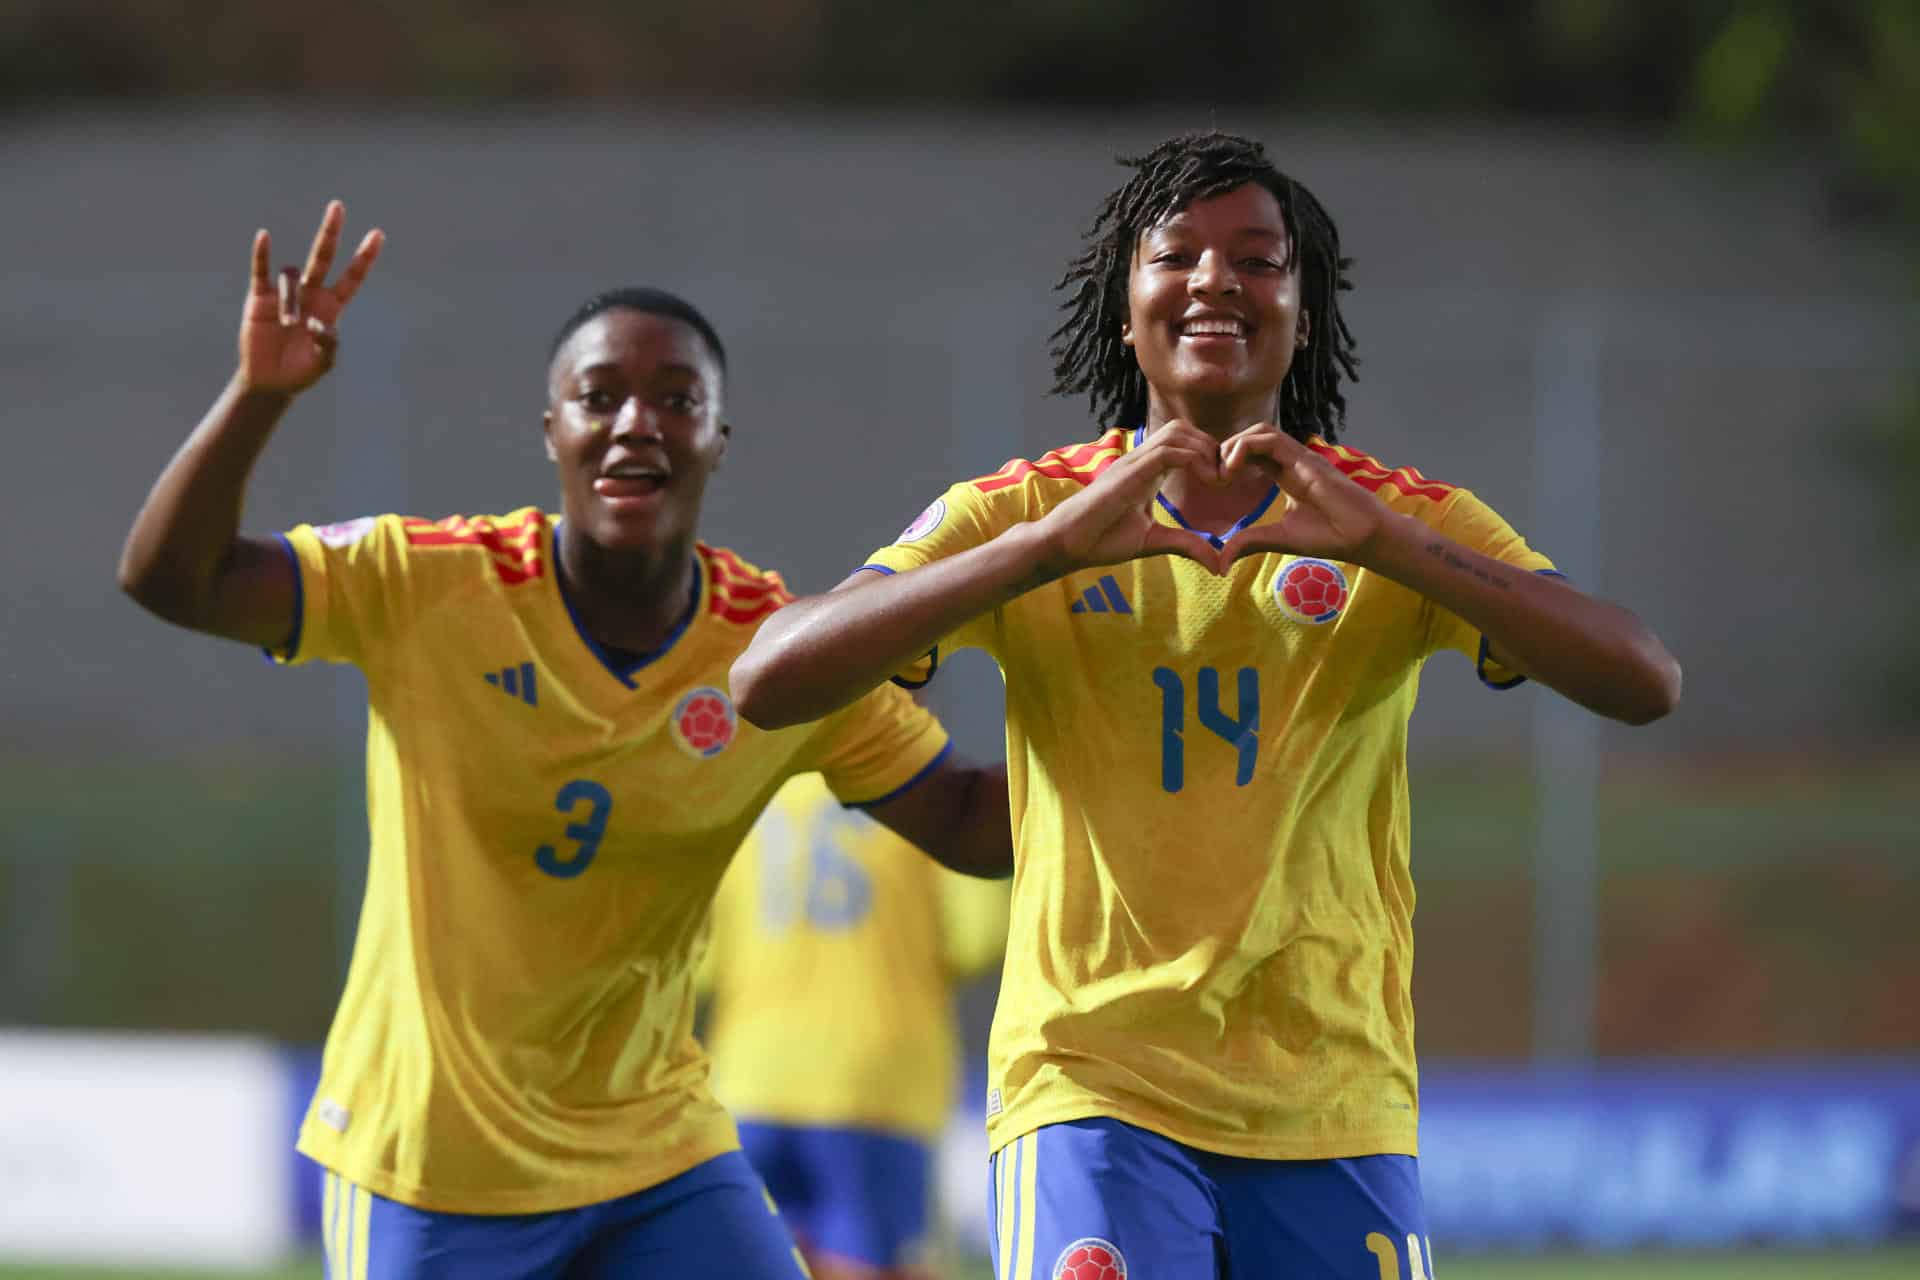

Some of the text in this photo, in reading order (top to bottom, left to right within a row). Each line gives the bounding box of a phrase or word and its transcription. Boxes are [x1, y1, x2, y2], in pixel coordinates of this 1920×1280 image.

[1152, 666, 1260, 793] 14
[535, 779, 613, 880] 3
[760, 801, 875, 936] 16
